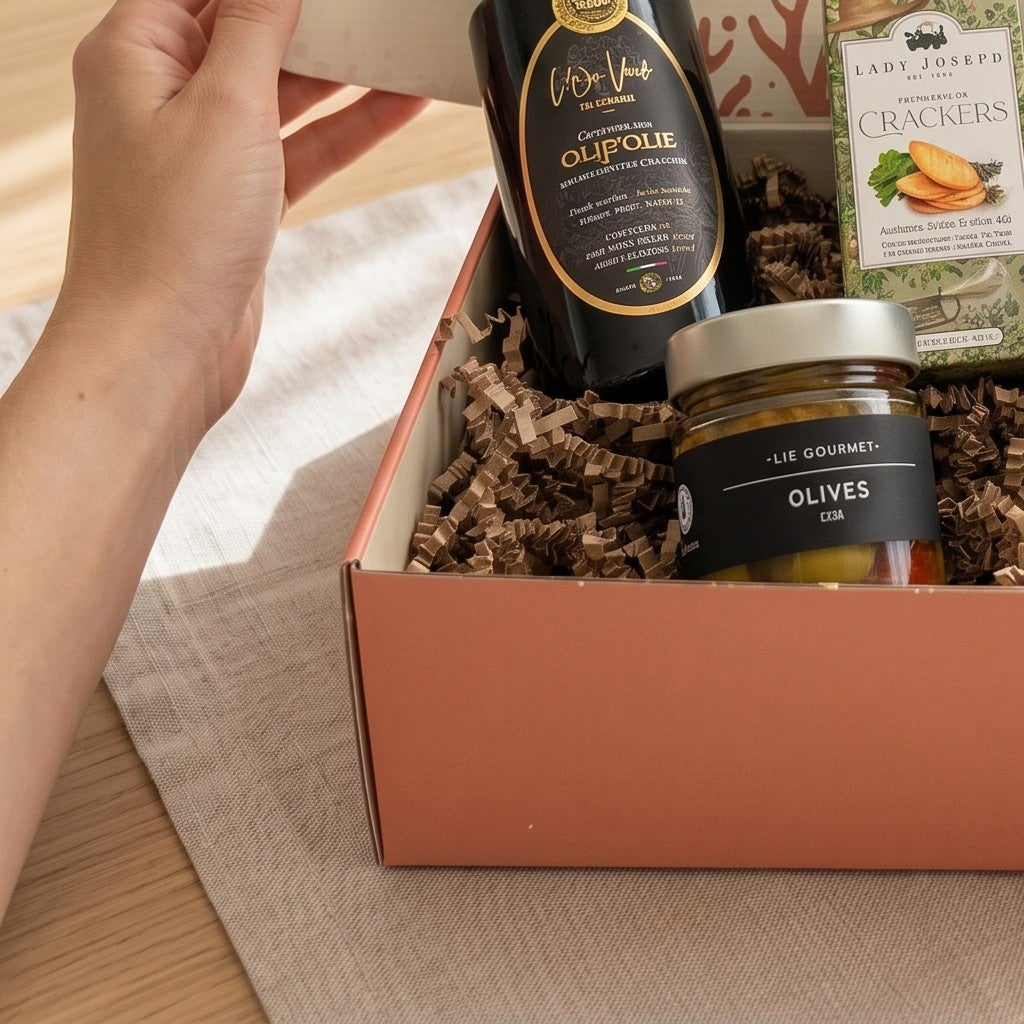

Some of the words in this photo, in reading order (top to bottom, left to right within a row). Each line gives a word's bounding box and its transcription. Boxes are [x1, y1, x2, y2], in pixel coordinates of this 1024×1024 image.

[855, 60, 908, 76] LADY
[858, 101, 1009, 139] CRACKERS
[788, 480, 870, 508] OLIVES
